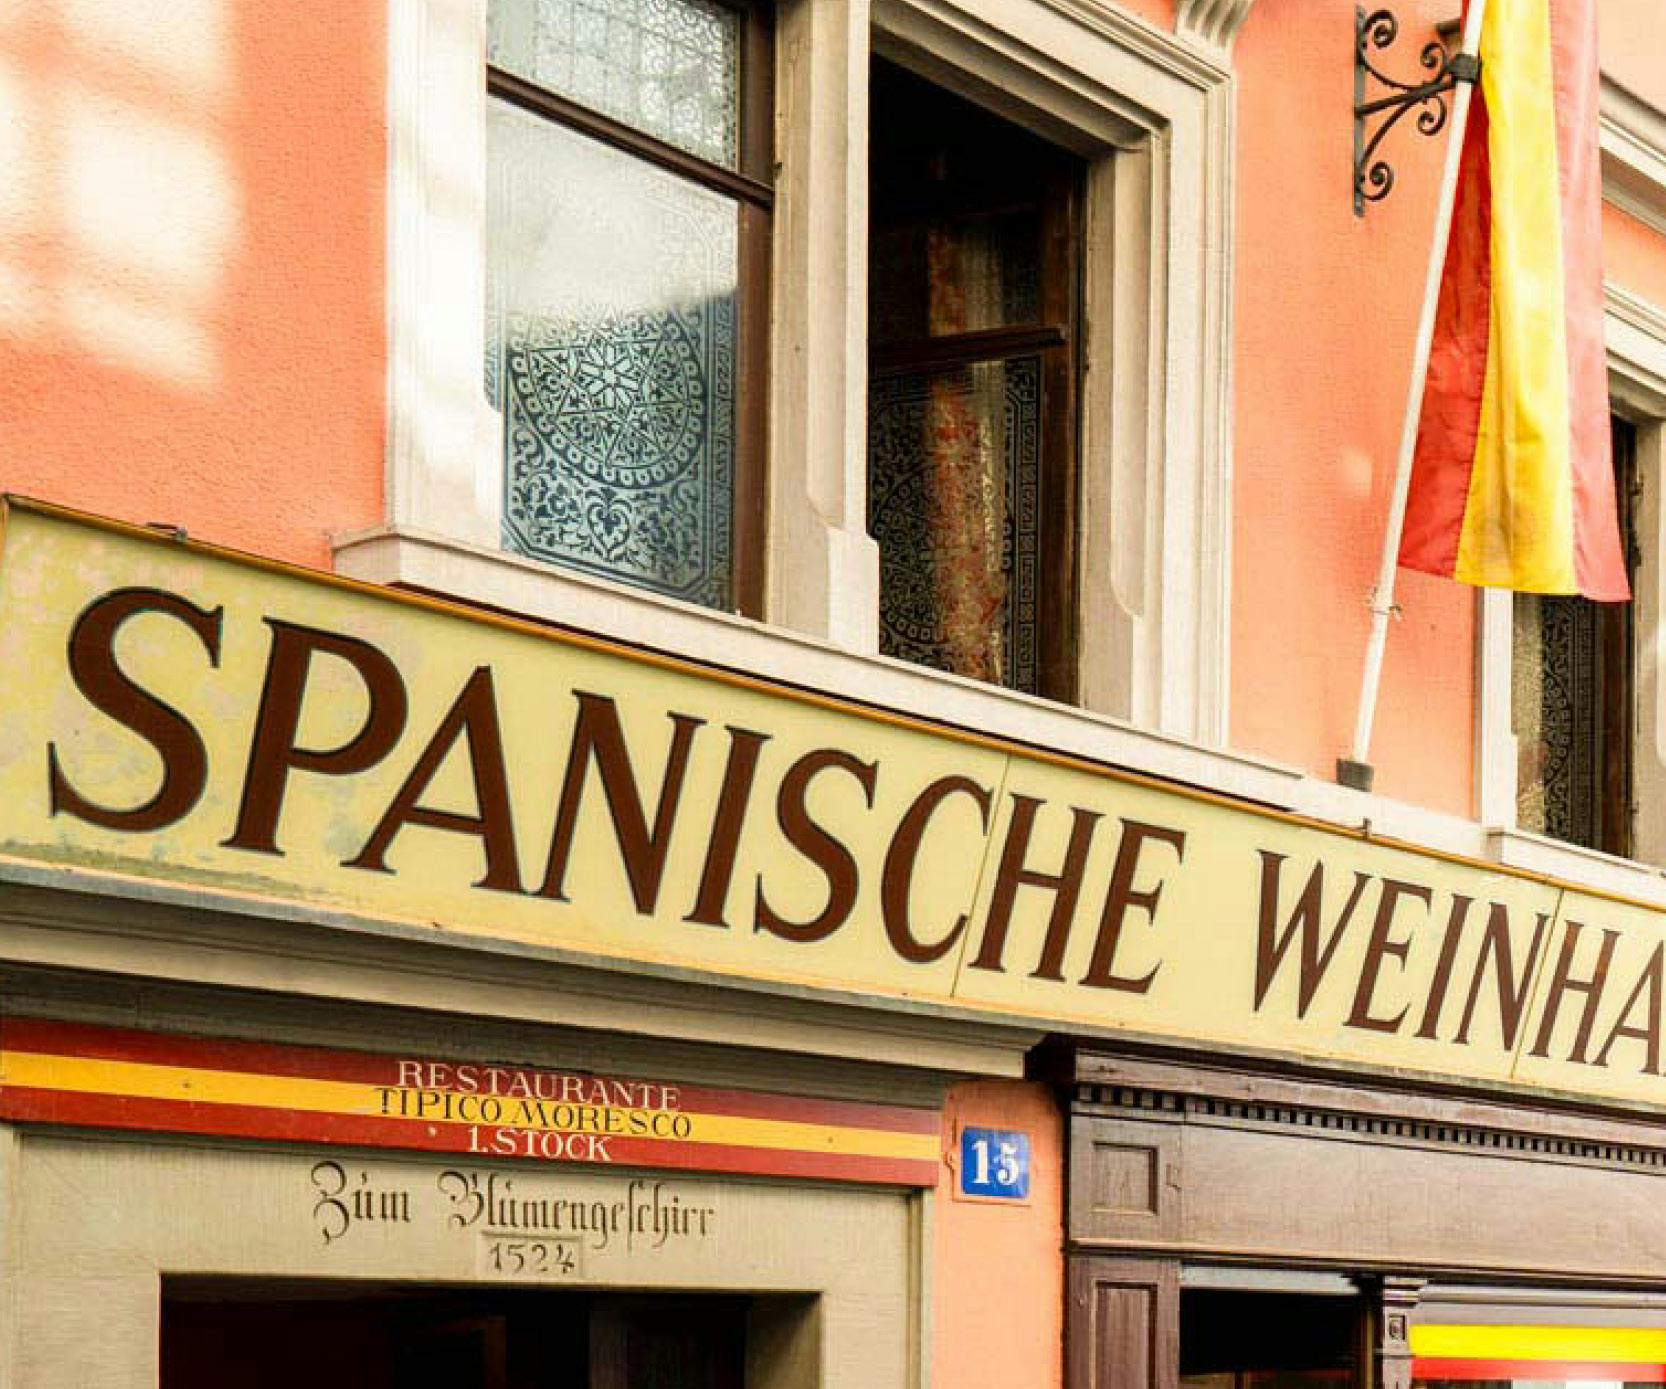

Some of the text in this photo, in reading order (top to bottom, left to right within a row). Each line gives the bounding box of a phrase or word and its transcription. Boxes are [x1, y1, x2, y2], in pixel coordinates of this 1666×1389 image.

[49, 585, 1188, 995] SPANISCHE
[397, 1060, 682, 1111] RESTAURANTE
[375, 1087, 693, 1139] TIPICO MORESCO
[971, 1140, 1019, 1186] 15
[488, 1241, 576, 1275] 1524
